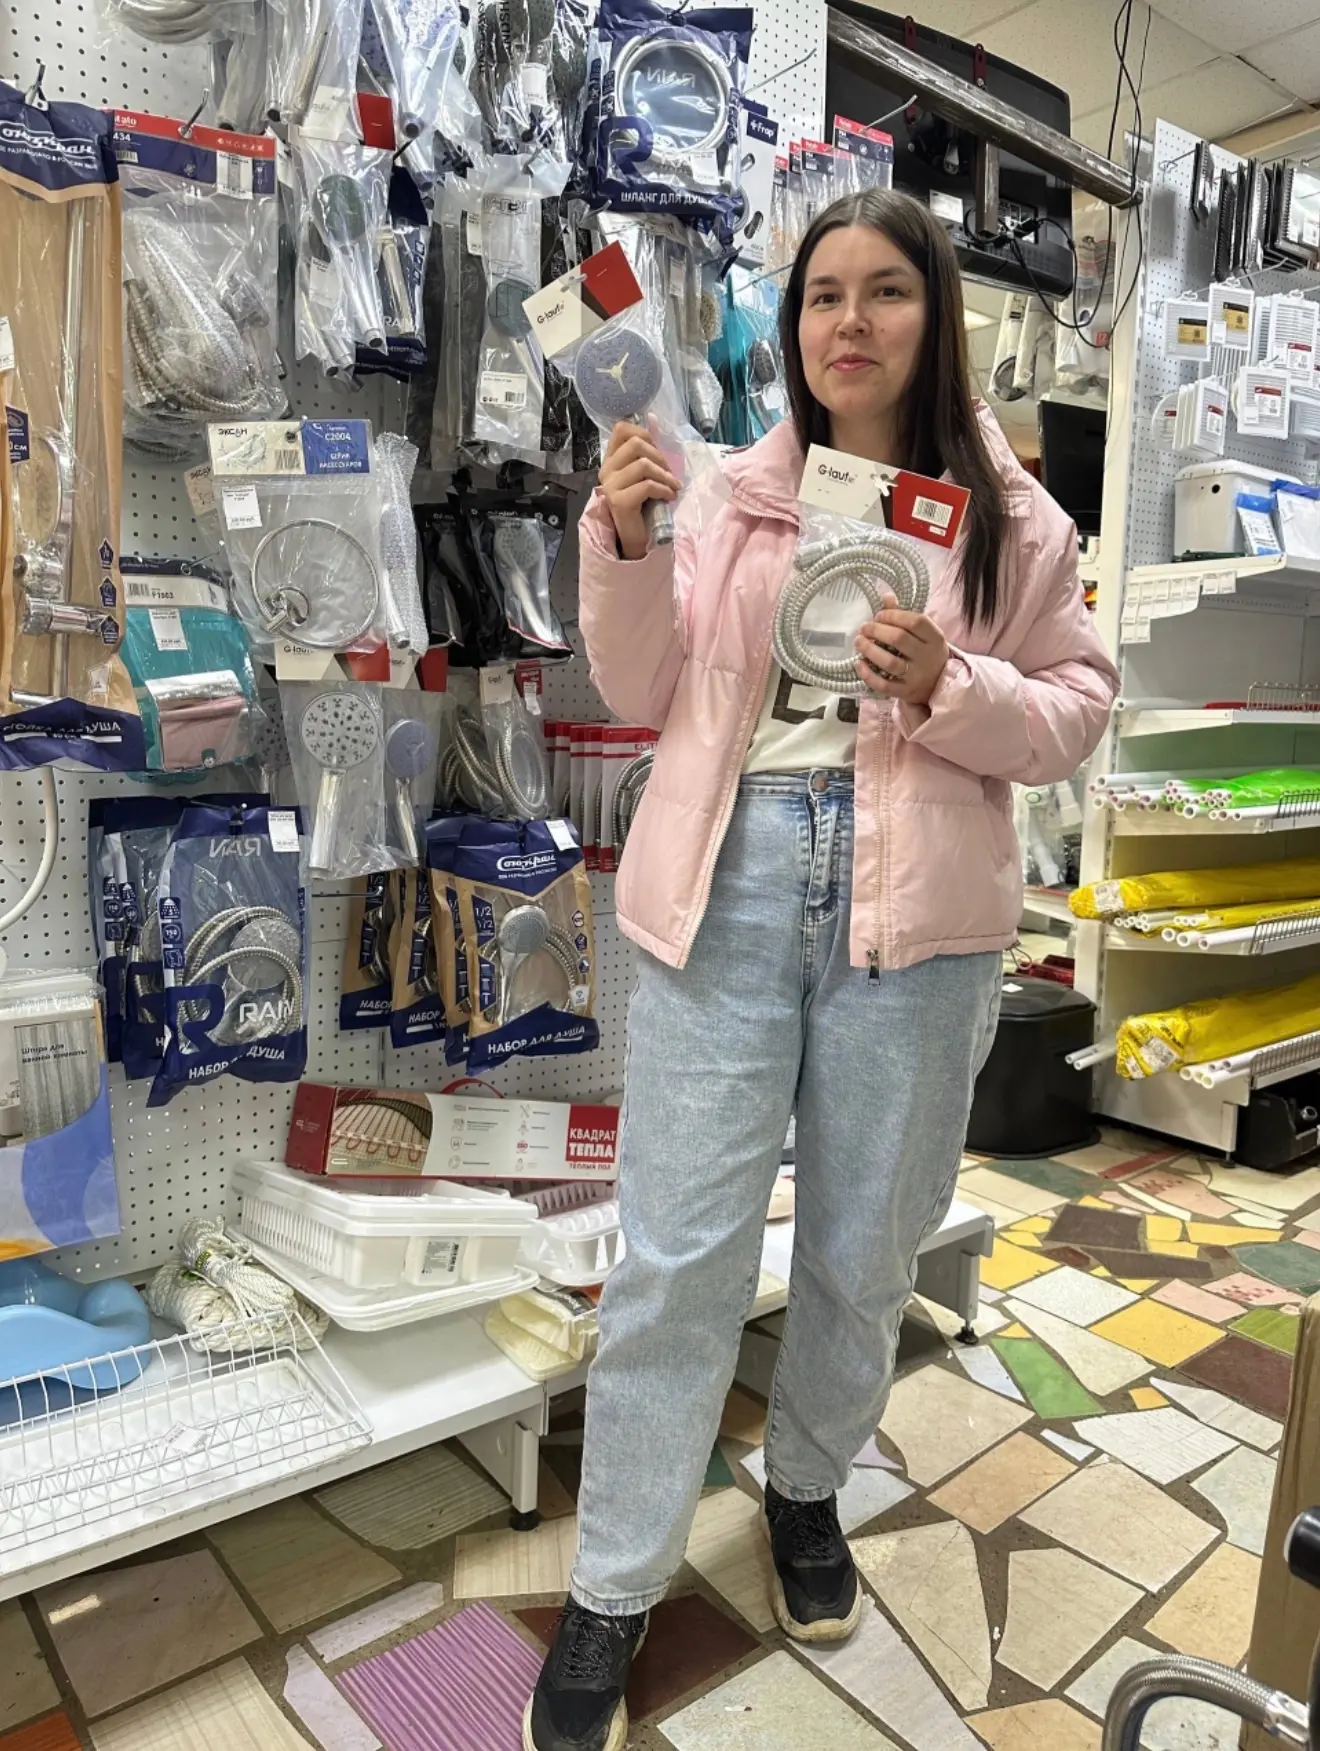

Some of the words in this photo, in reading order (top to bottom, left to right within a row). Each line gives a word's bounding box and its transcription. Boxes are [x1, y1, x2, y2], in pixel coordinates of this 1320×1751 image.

[757, 122, 775, 138] Frap
[620, 191, 657, 203] ШЛАНГ
[659, 192, 682, 205] ДЛЯ
[475, 906, 492, 918] 1/2
[239, 998, 296, 1024] RAIN
[408, 1011, 441, 1024] НАБОР
[487, 1038, 528, 1055] НАБОР
[529, 1033, 553, 1046] ДЛЯ
[554, 1025, 586, 1039] ДУША
[188, 1060, 229, 1080] НАБОР
[247, 1045, 285, 1060] ДУША
[569, 1127, 617, 1142] КВАДРАТ
[568, 1142, 614, 1158] ТЕПЛА
